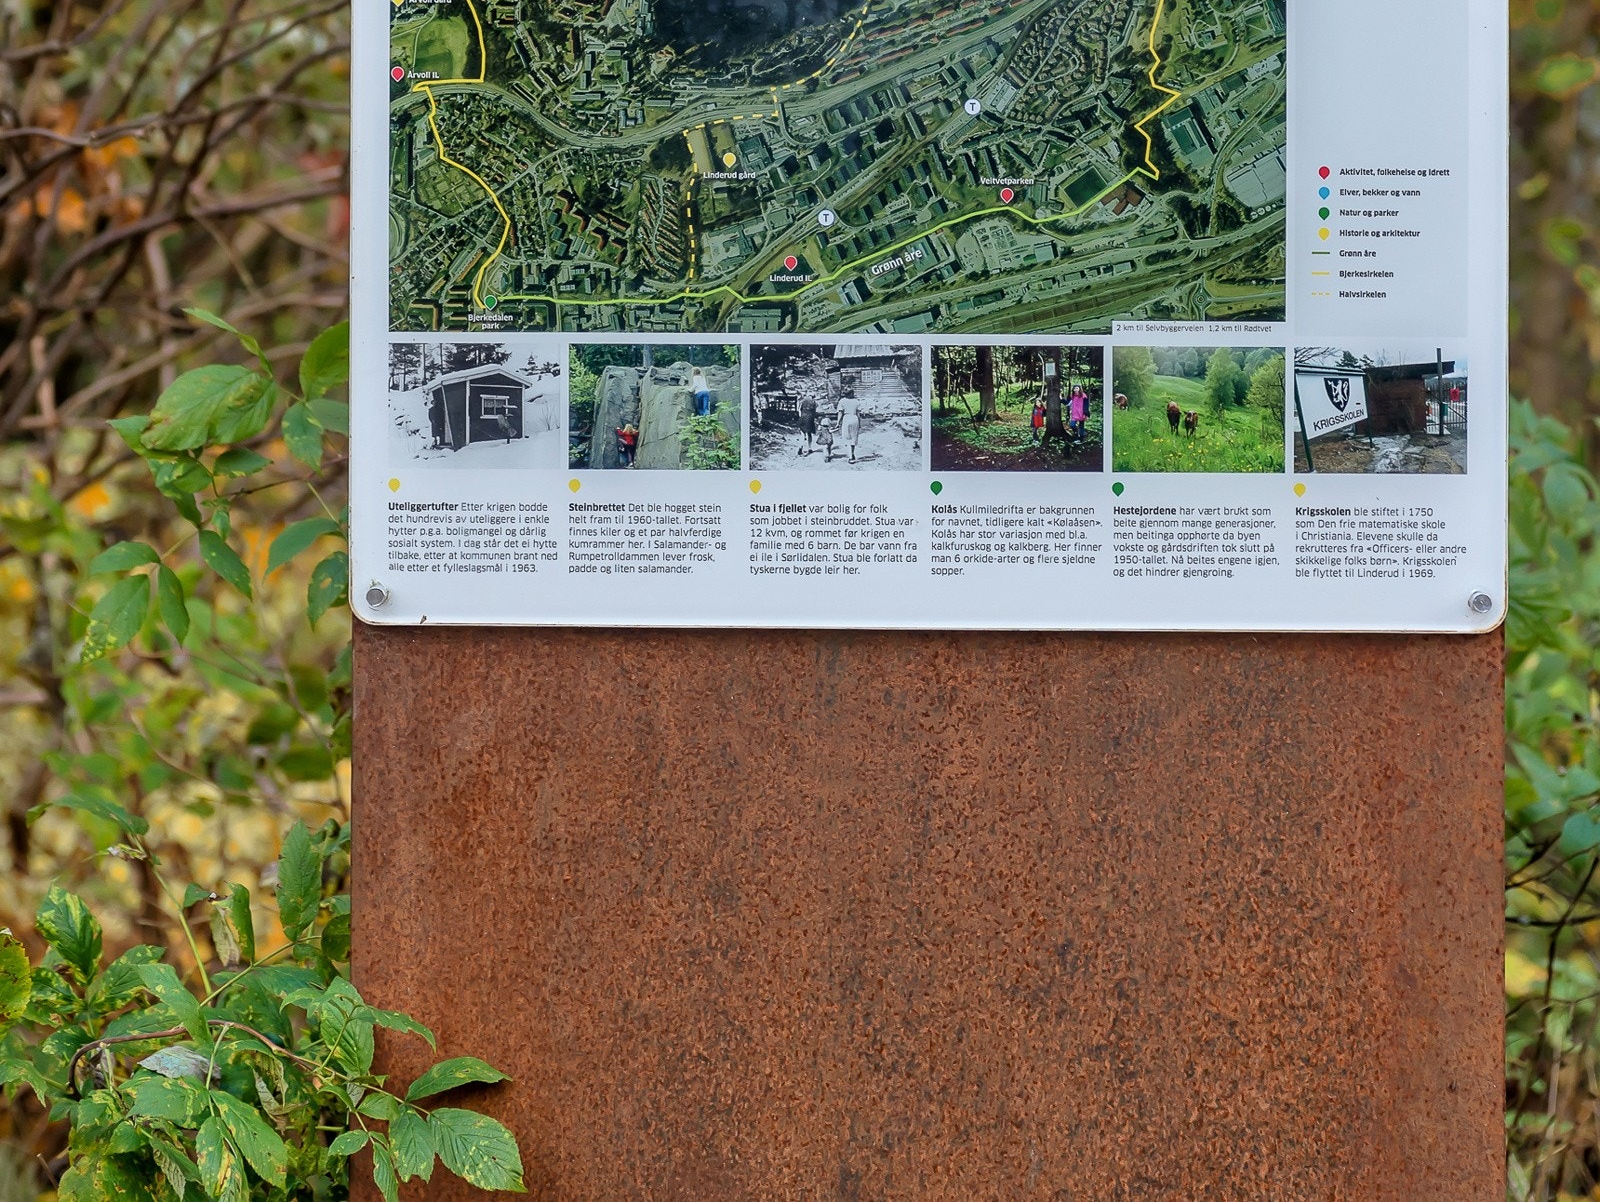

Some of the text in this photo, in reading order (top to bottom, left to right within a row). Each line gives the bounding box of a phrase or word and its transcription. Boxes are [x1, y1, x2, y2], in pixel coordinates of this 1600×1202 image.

[969, 102, 976, 112] T
[703, 171, 756, 180] Linderud gård
[1339, 168, 1375, 176] Aktivitet,
[1377, 168, 1416, 176] folkehelse
[1428, 168, 1450, 176] idrett
[980, 177, 1034, 186] Veitvetparken
[1340, 188, 1361, 197] Elver,
[823, 213, 830, 222] T
[1362, 210, 1372, 218] og
[1374, 209, 1399, 217] parker
[1339, 229, 1369, 237] Historie
[1382, 229, 1421, 237] arkitektur
[1364, 249, 1376, 257] åre
[871, 248, 922, 276] Grønn åre
[1339, 270, 1394, 279] Bjerkesirkelen
[1339, 290, 1386, 298] Halvsirkelen
[468, 313, 514, 322] Bjerkedalen
[481, 322, 500, 330] park
[1145, 324, 1204, 333] Selvbyggerveien
[1234, 324, 1242, 332] til
[1313, 408, 1365, 432] KRIGSSKOLEN
[388, 502, 548, 512] Uteliggertufter Etter krigen bodde
[569, 502, 721, 514] Steinbrettet Det ble hogget stein
[750, 504, 771, 513] Stua
[778, 503, 807, 514] fjellet
[808, 505, 824, 513] var
[827, 504, 850, 515] bolig
[853, 504, 867, 513] for
[870, 504, 888, 514] folk
[931, 504, 1095, 516] Kolås Kullmiledrifta er bakgrunnen
[1113, 506, 1271, 516] Hestejordene har vært brukt som
[1295, 507, 1351, 517] Krigsskolen
[1354, 507, 1368, 516] ble
[1371, 507, 1399, 516] stiftet
[1409, 507, 1433, 517] 1750
[388, 514, 403, 523] det
[406, 514, 453, 524] hundrevis
[470, 514, 516, 524] uteliggere
[524, 514, 550, 524] enkle
[569, 515, 721, 525] helt fram til 1960-tallet. Fortsatt
[750, 517, 769, 525] som
[771, 516, 802, 527] jobbet
[810, 516, 872, 526] steinbruddet.
[875, 516, 895, 526] Stua
[897, 518, 914, 526] var
[931, 517, 1103, 528] for navnet, tidligere kalt «Kølaåsen».
[1295, 519, 1446, 529] som Den frie matematiske skole
[1113, 518, 1137, 528] beite
[1139, 518, 1179, 531] gjennom
[1181, 520, 1212, 529] mange
